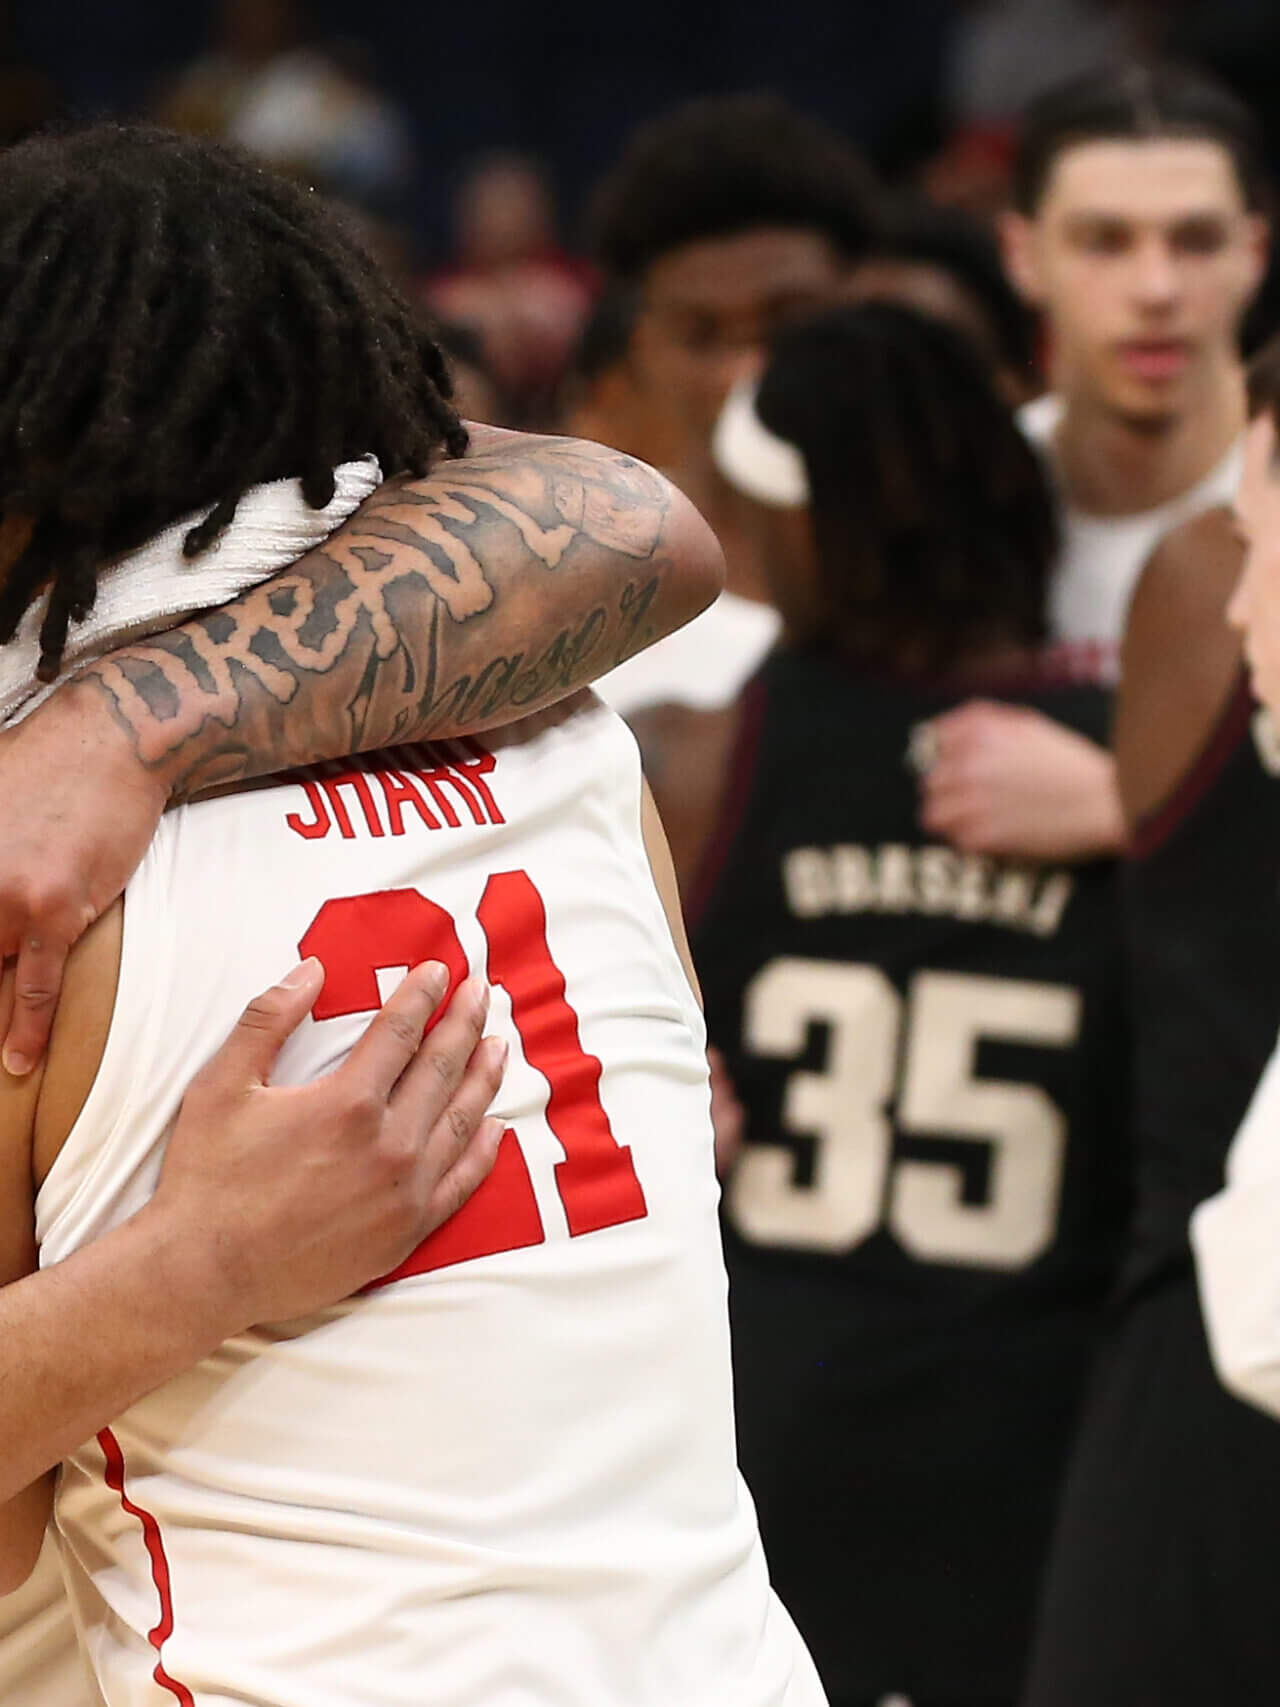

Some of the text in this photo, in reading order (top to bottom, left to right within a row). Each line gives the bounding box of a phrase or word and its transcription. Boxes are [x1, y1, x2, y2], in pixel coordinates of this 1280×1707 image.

[280, 744, 506, 840] SHARP
[297, 869, 648, 1300] 21
[730, 955, 1084, 1272] 35
